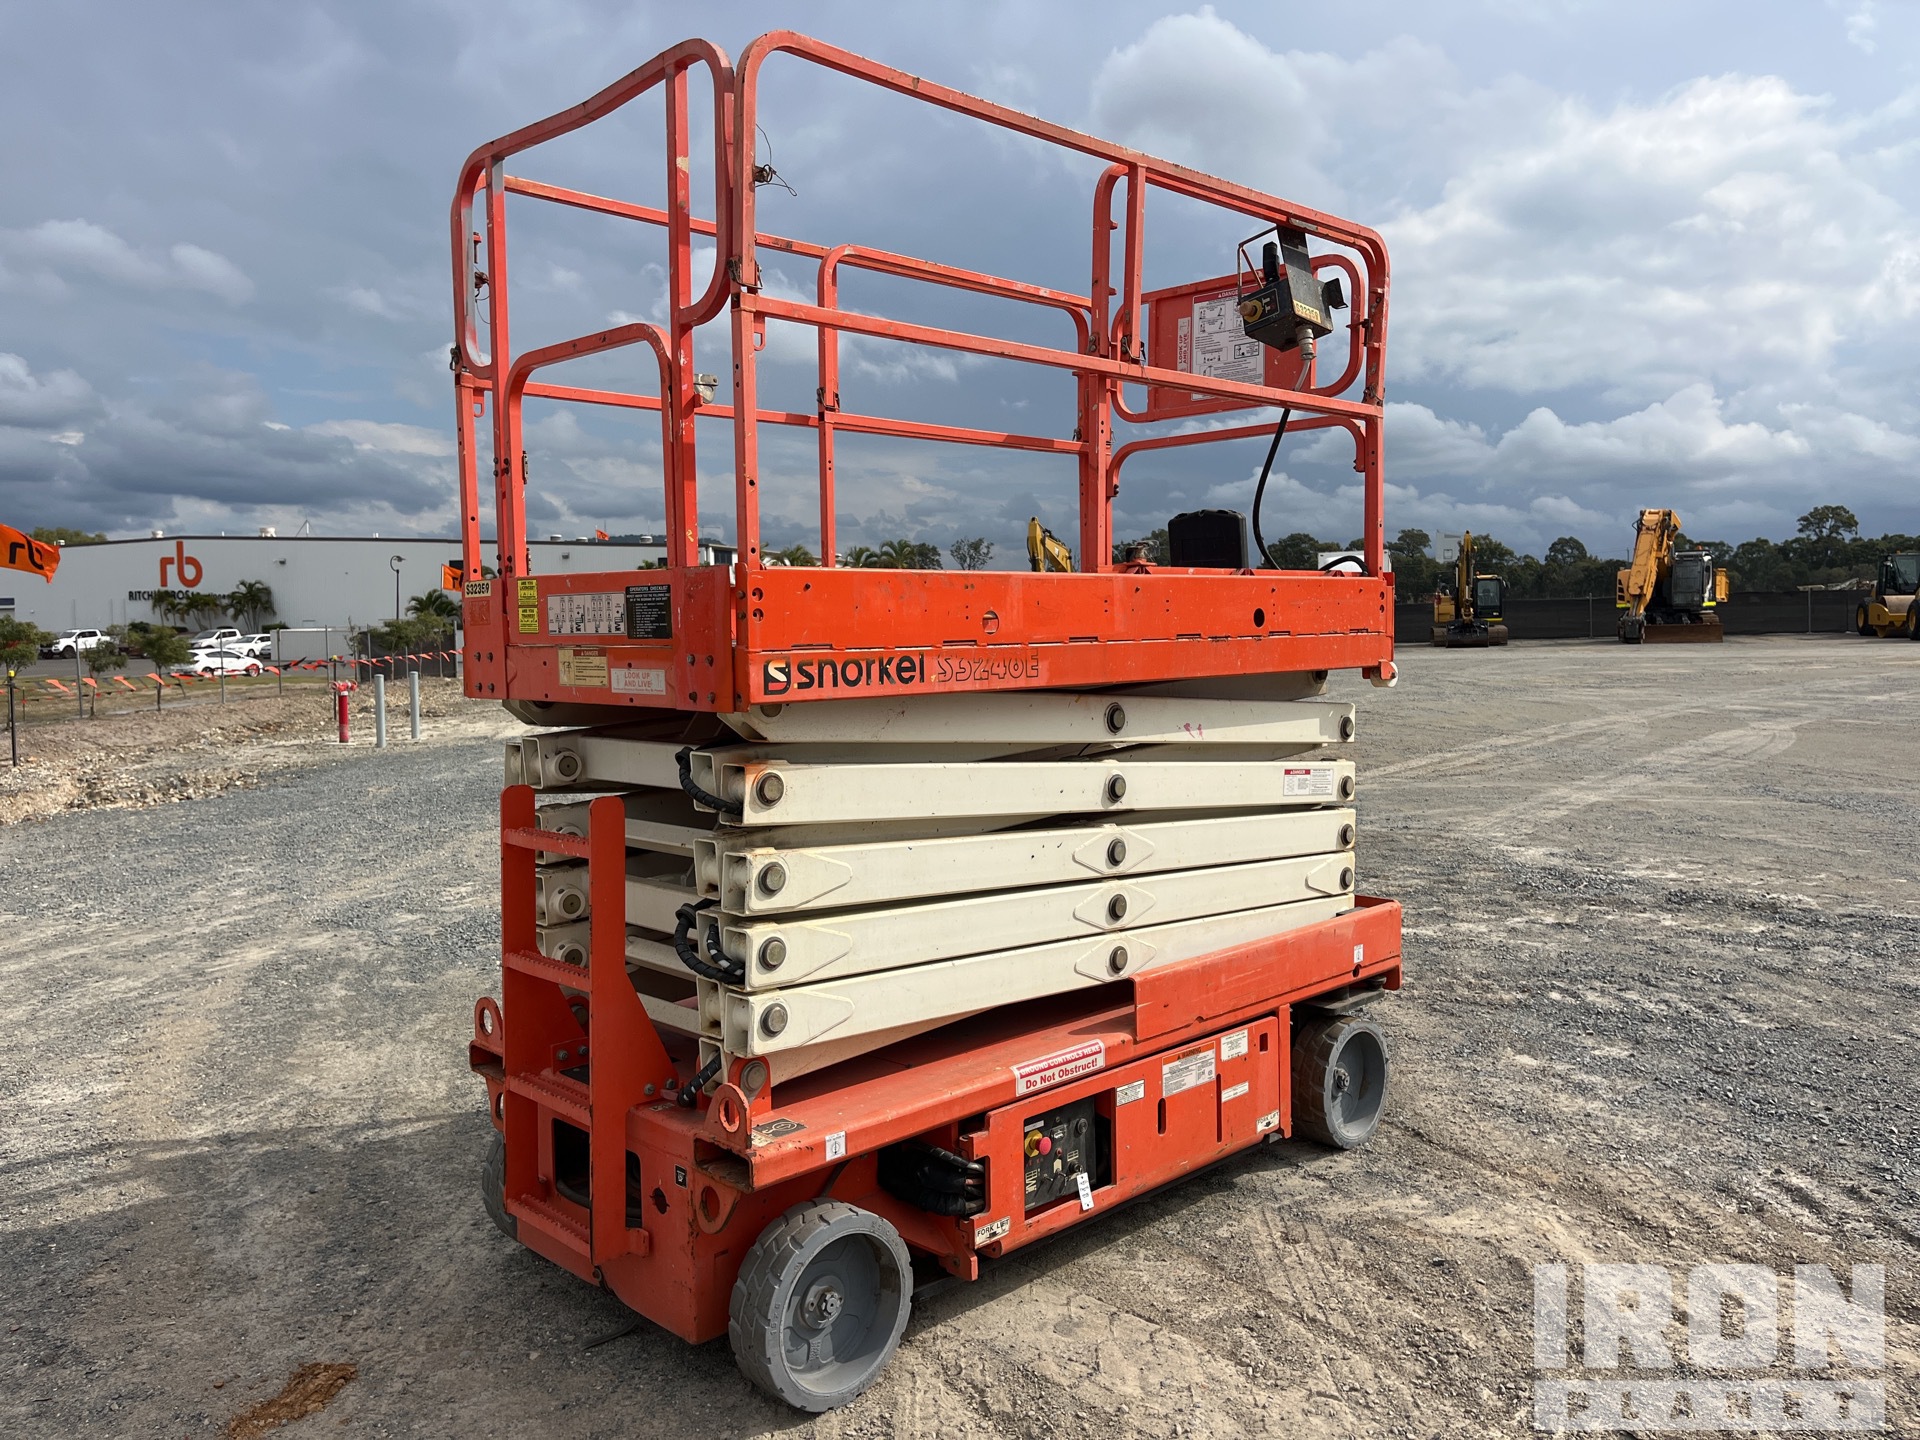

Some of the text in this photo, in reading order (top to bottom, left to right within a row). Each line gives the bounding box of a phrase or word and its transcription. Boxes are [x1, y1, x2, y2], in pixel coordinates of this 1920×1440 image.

[160, 540, 203, 588] rb
[466, 582, 490, 596] S32359
[641, 672, 651, 680] UP
[797, 652, 925, 690] snorkel
[637, 680, 652, 688] LIVE
[1020, 1061, 1049, 1075] GROUND
[1049, 1051, 1083, 1067] CONTROLS
[1025, 1057, 1098, 1090] Do Not Obstruct!
[977, 1225, 994, 1237] FORK
